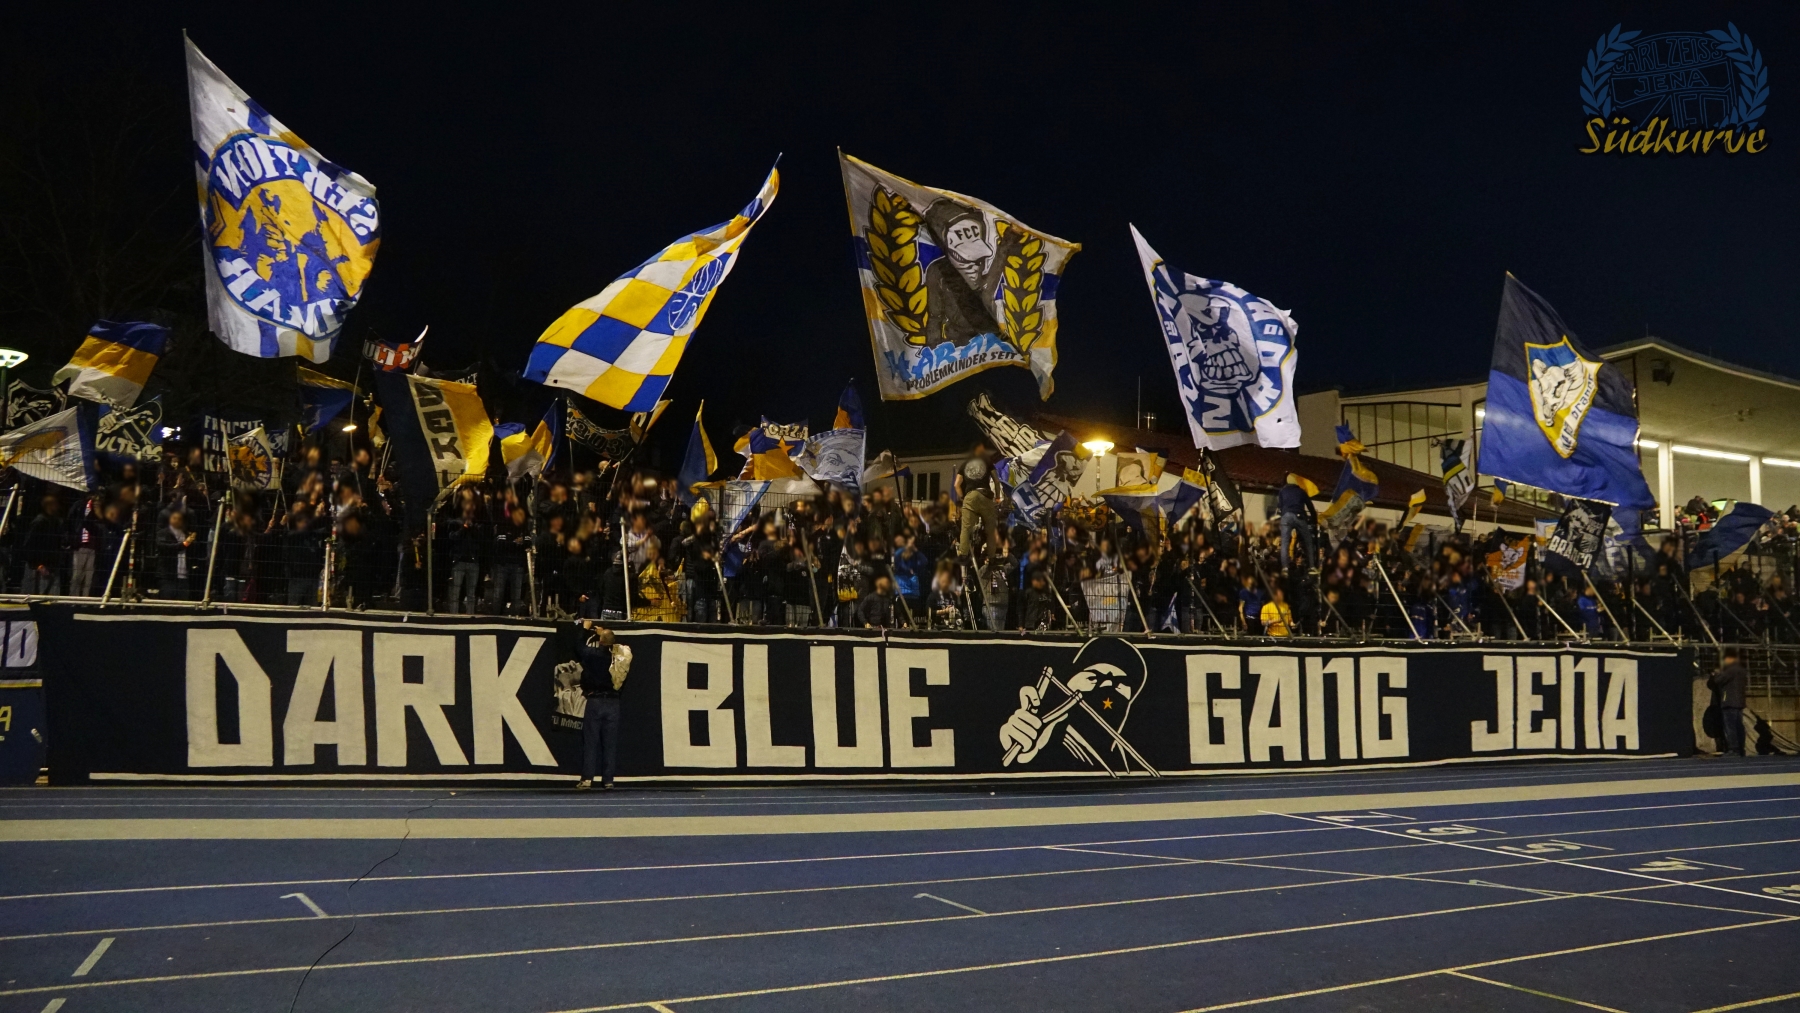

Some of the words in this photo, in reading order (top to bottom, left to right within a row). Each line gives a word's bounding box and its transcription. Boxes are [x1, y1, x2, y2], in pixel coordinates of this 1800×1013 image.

[956, 225, 980, 240] FCC
[906, 353, 987, 391] PROBLEMKINDER
[95, 433, 163, 462] ULTRAS
[186, 628, 559, 767] DARK
[660, 640, 956, 769] BLUE
[1185, 653, 1409, 765] GANG
[1470, 654, 1639, 753] JENA
